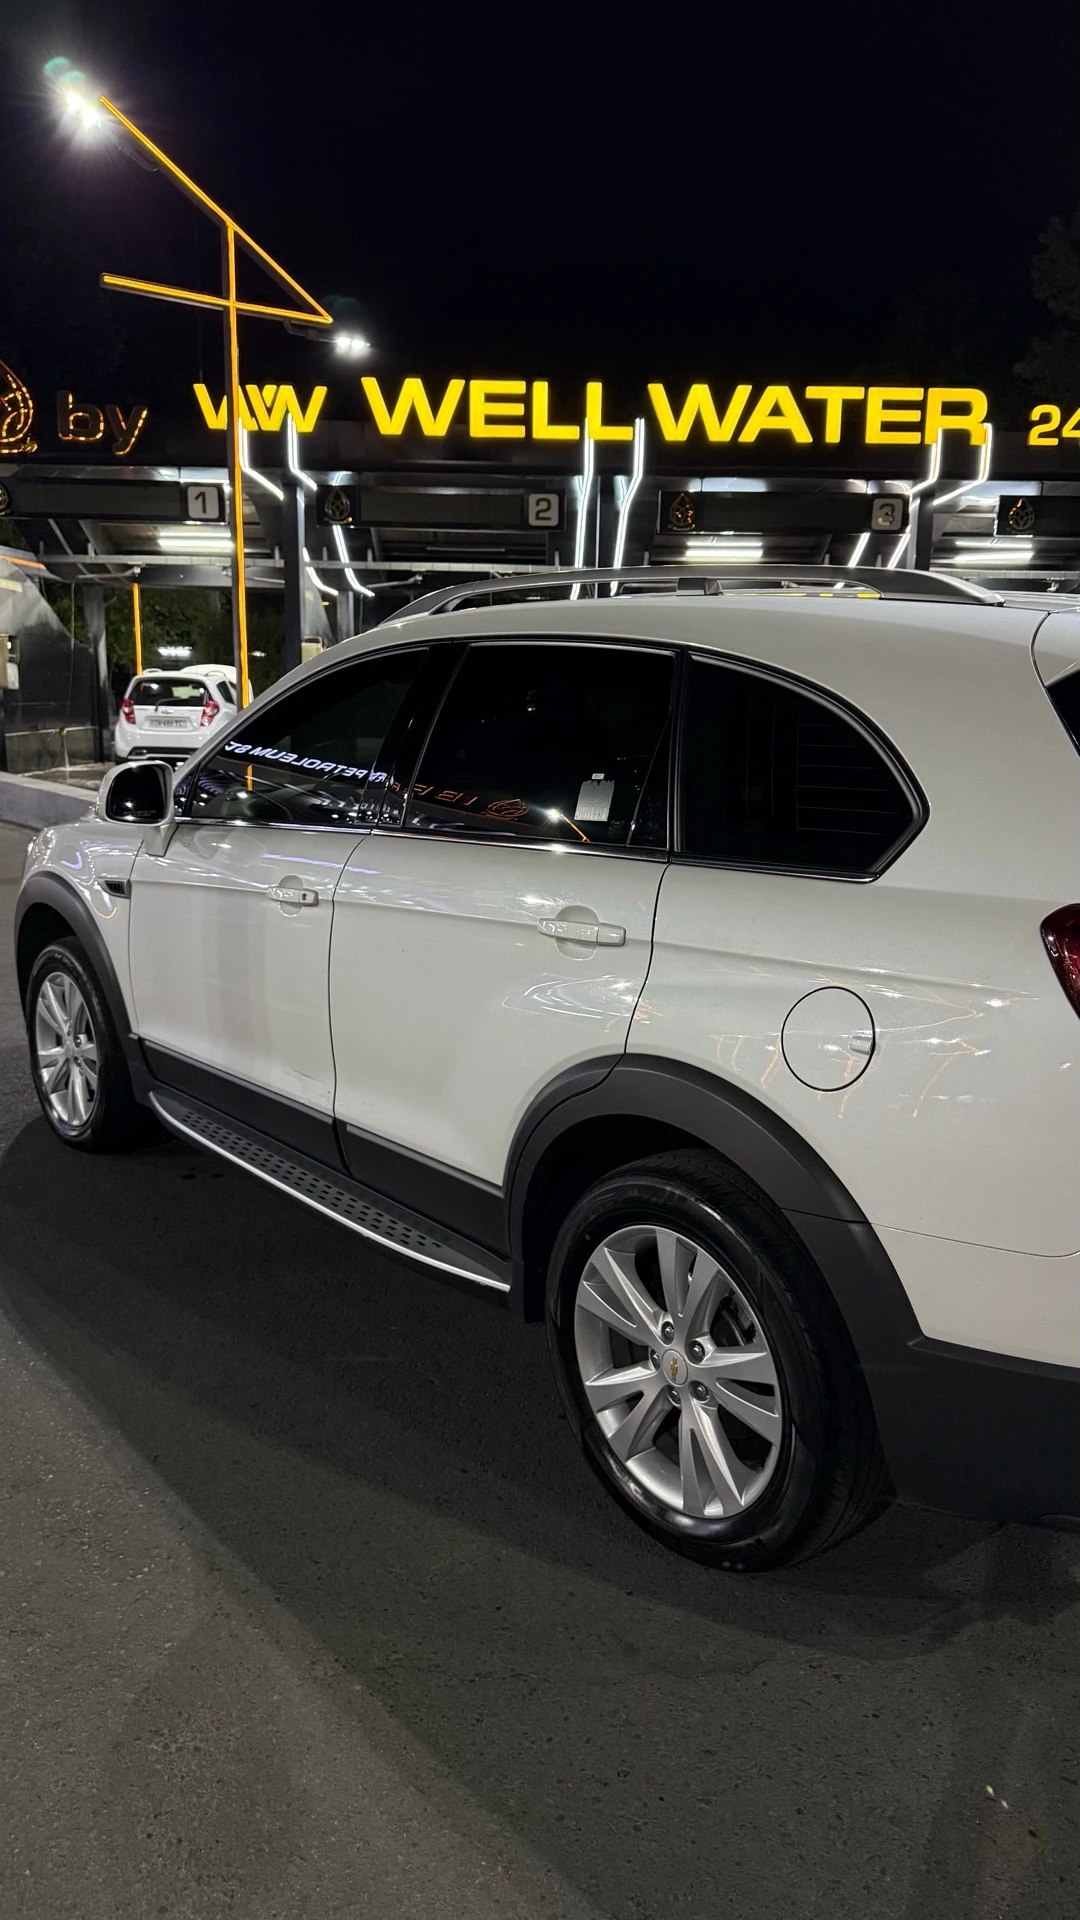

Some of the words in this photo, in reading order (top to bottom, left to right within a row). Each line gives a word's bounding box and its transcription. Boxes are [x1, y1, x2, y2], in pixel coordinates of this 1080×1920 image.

[57, 390, 149, 455] by
[360, 376, 634, 441] WELL
[647, 383, 988, 448] WATER
[194, 491, 207, 515] 1
[535, 497, 552, 521] 2
[877, 502, 896, 526] 3
